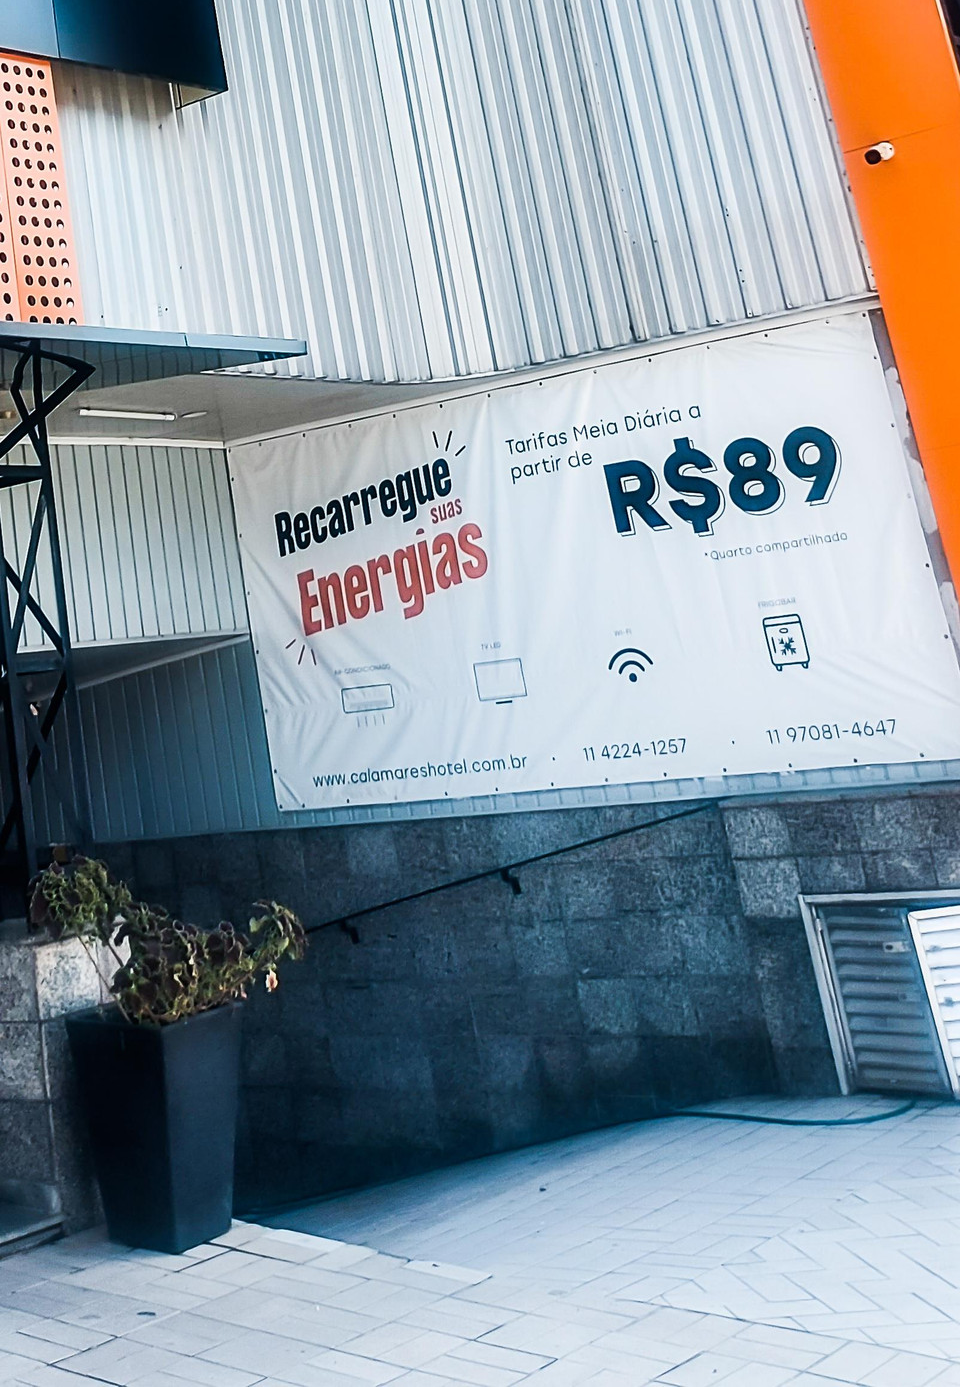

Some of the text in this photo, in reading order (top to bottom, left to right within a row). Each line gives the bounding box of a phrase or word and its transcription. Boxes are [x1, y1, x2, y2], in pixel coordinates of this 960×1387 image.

[505, 405, 702, 455] Tarifas Meia Diária a
[510, 450, 593, 485] partir de
[603, 425, 842, 537] R$89
[274, 457, 453, 558] Recarregue
[430, 498, 463, 525] suas
[755, 531, 848, 554] compartilhado
[296, 522, 489, 637] Energias
[766, 718, 897, 745] 11 97081-4647
[312, 737, 687, 788] www.calamareshotel.com.br 11 4224-1257
